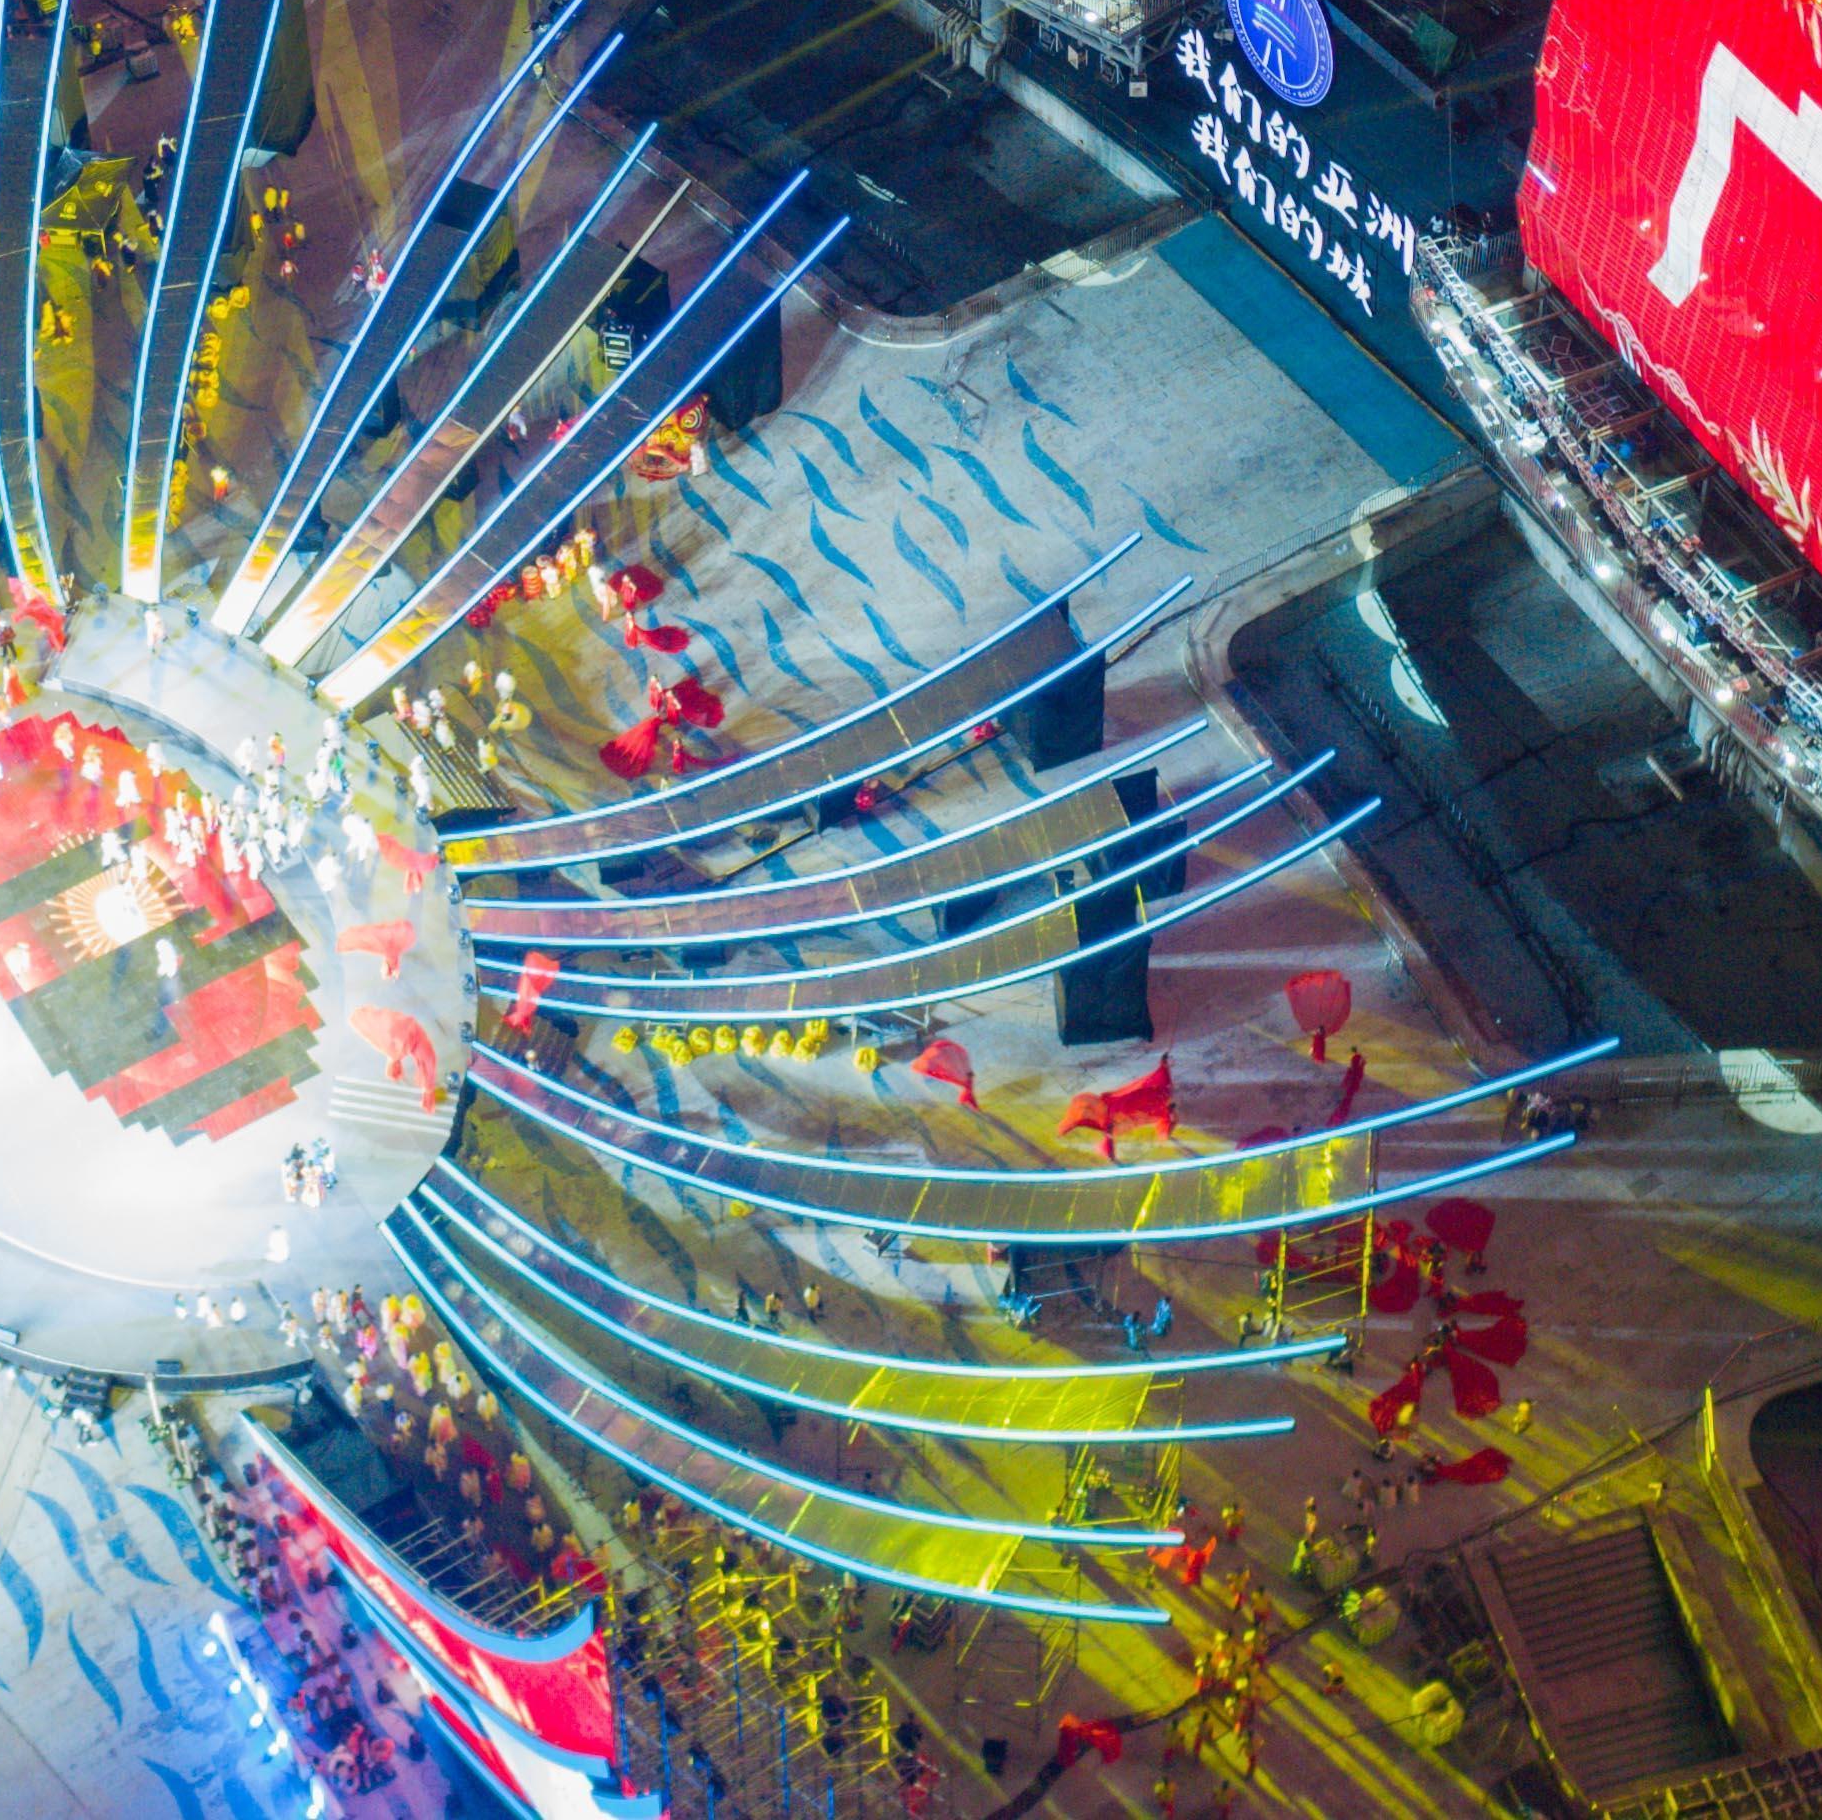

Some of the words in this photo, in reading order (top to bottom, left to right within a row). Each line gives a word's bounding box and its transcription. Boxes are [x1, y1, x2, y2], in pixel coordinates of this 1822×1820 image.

[1176, 28, 1415, 275] 我们的亚洲
[1191, 113, 1372, 317] 我们的城
